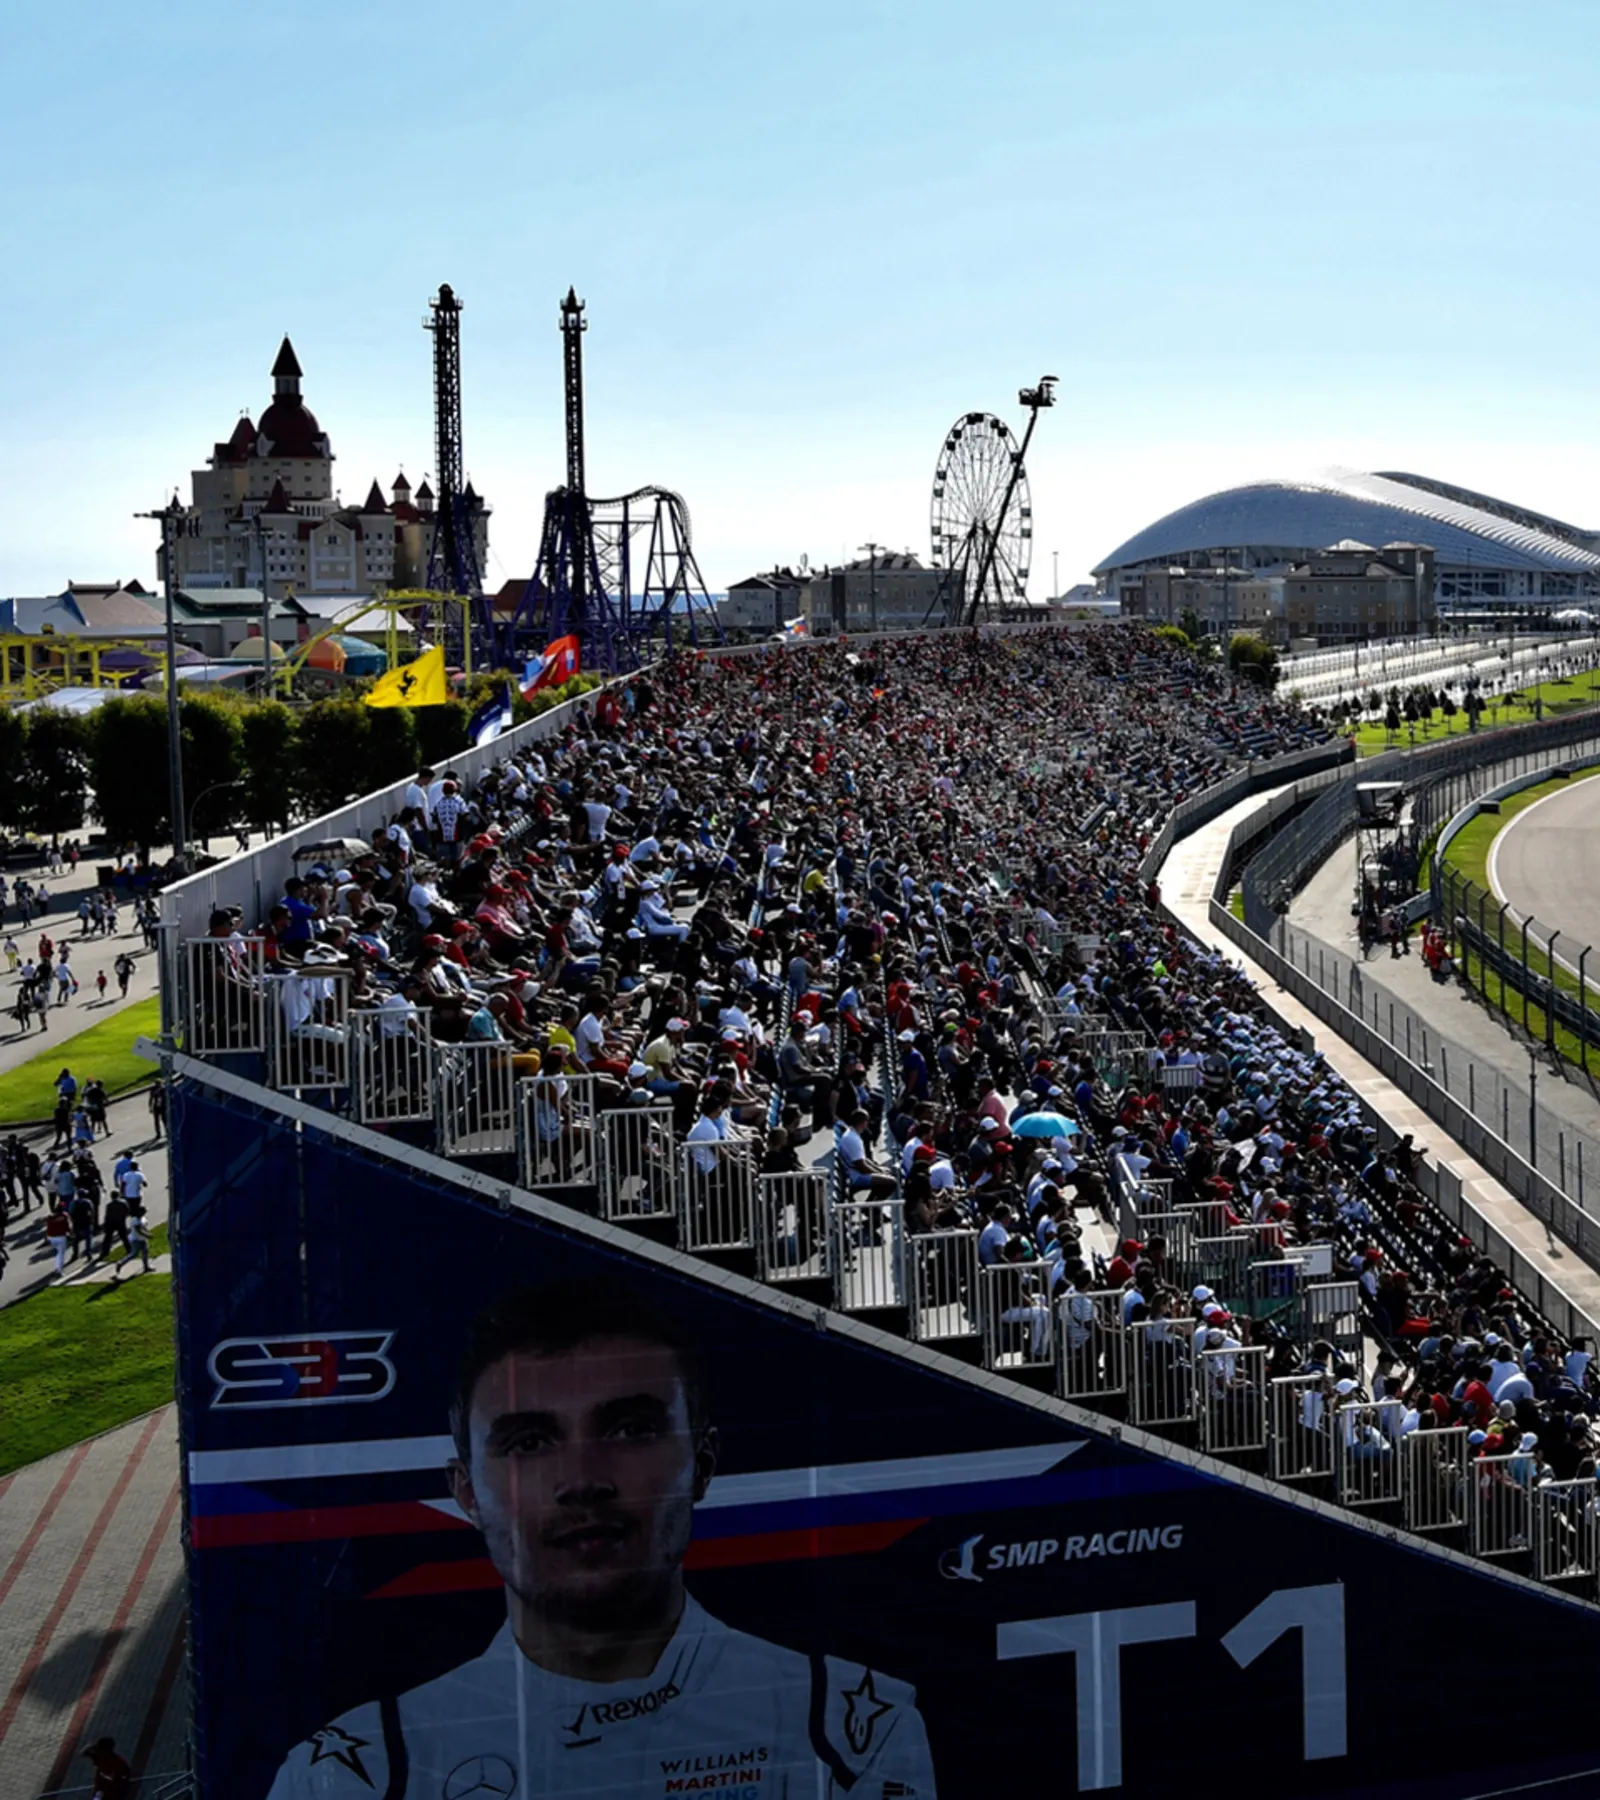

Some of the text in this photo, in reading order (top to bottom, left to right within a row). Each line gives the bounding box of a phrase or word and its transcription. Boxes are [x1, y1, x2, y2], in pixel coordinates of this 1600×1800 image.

[985, 1523, 1184, 1570] SMP RACING
[996, 1581, 1348, 1792] T1
[659, 1747, 768, 1774] WILLIAMS
[665, 1768, 761, 1792] MARTINI
